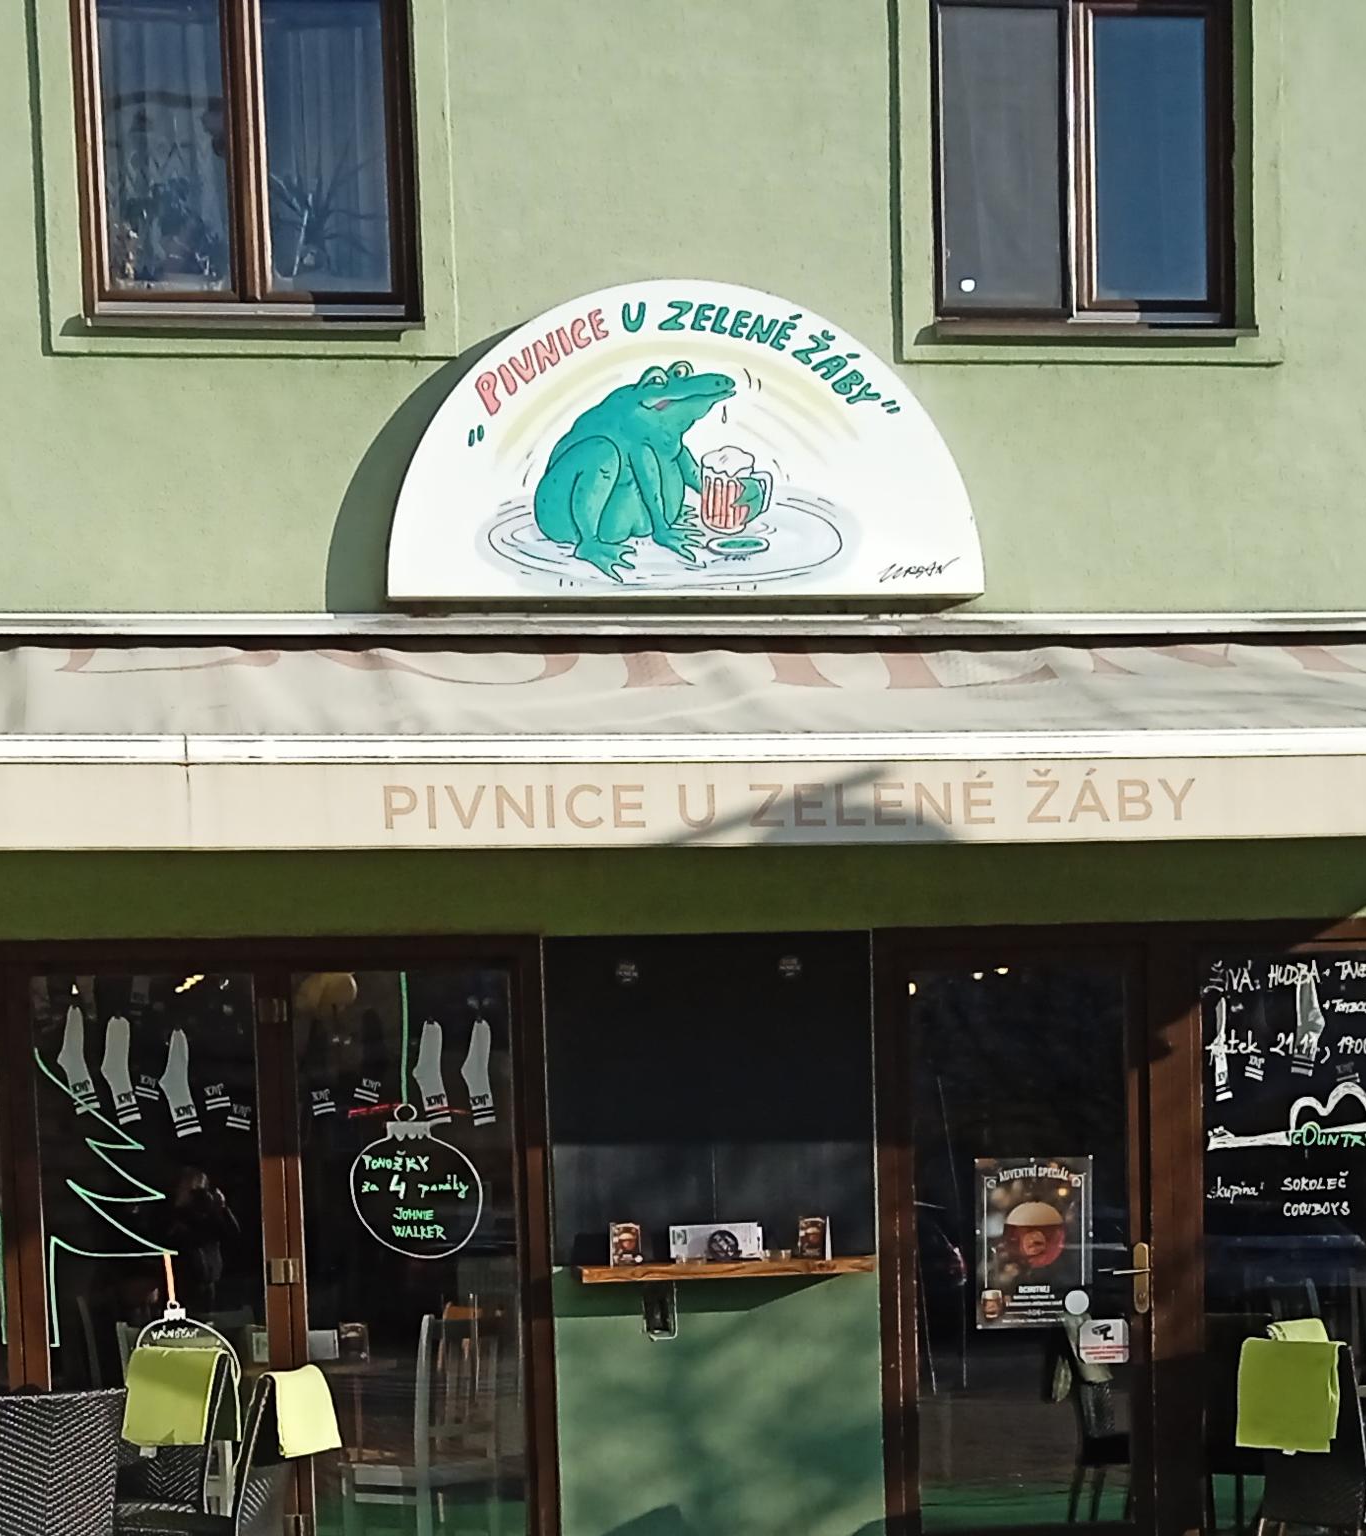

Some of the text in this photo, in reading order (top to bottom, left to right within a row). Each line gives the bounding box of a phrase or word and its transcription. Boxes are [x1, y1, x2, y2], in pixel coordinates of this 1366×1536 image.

[621, 301, 647, 333] U
[657, 300, 804, 352] ZELENÉ
[383, 767, 1196, 830] PIVNICE U ZELENÉ ŽÁBY
[1267, 959, 1321, 989] HUDBA
[389, 1174, 406, 1200] 4
